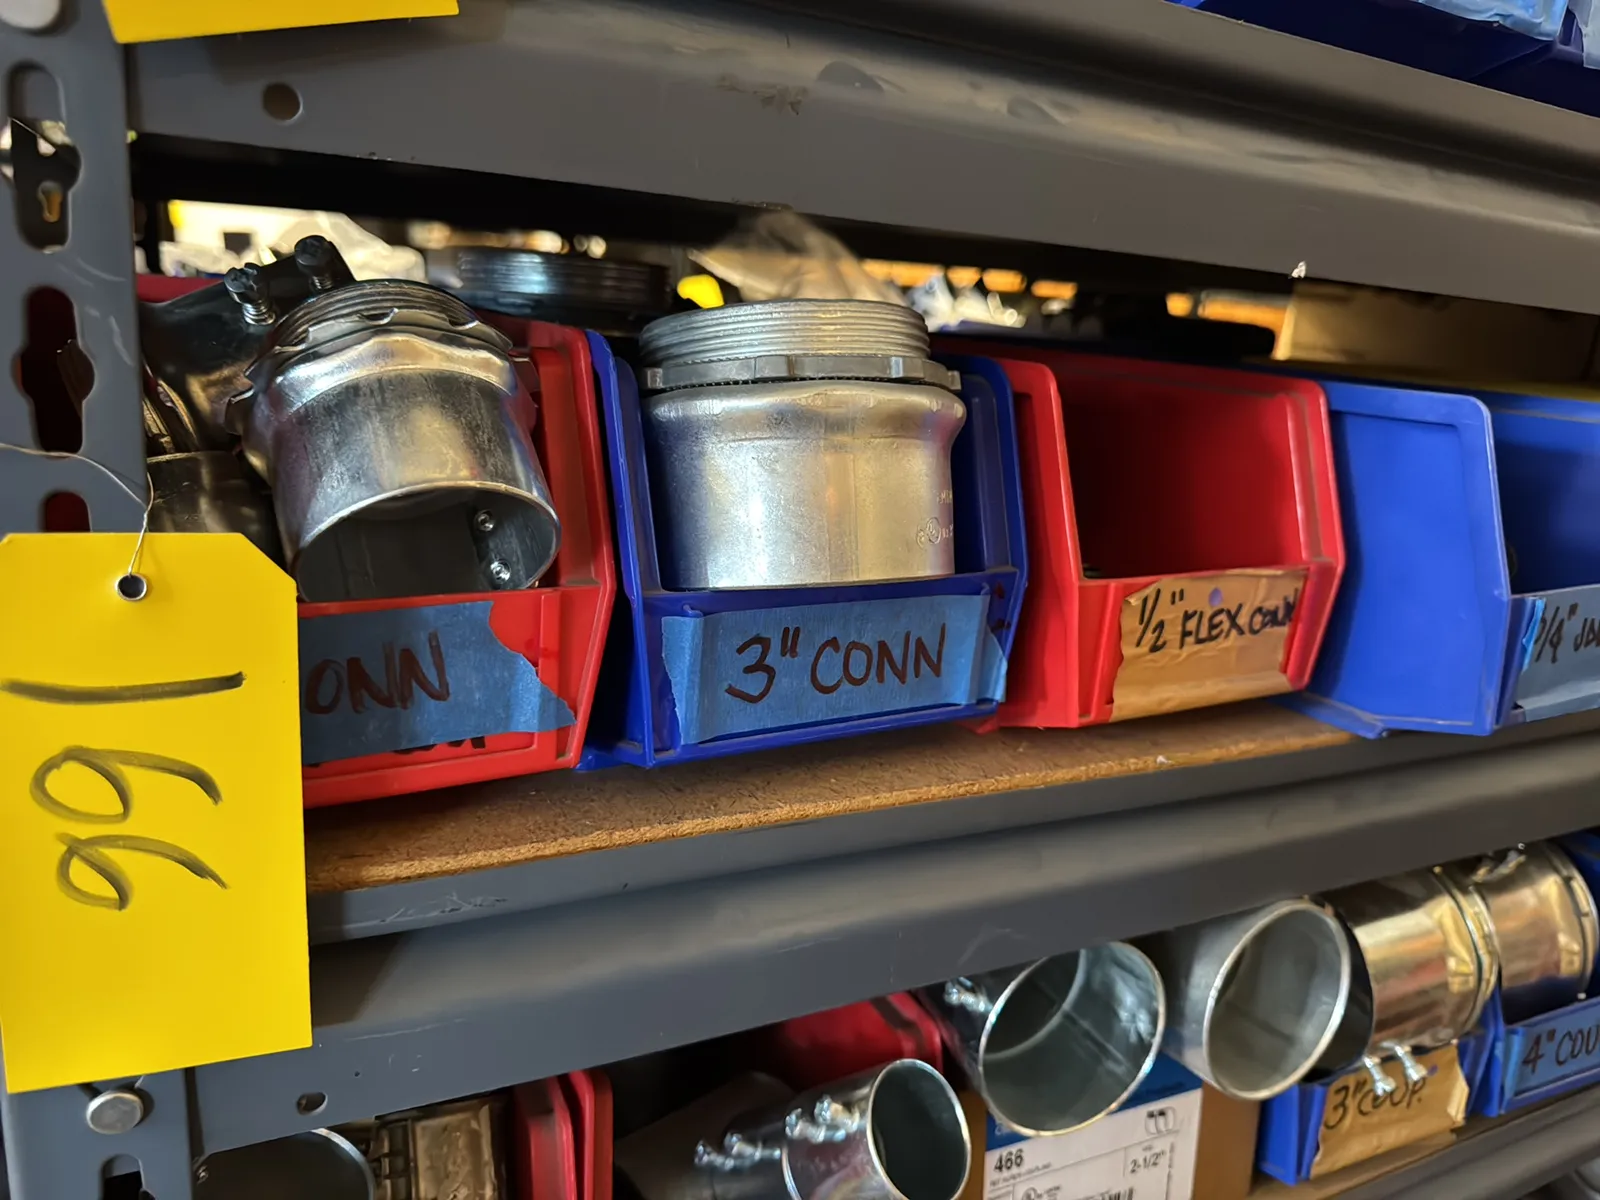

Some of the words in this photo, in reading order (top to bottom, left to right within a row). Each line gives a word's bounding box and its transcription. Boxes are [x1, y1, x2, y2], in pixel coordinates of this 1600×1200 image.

[1135, 587, 1185, 654] 1/2"
[1178, 602, 1246, 650] FLEX
[723, 626, 801, 704] 3"
[809, 621, 947, 695] CONN
[1521, 1027, 1558, 1076] 4"
[1323, 1077, 1368, 1130] 3"
[993, 1148, 1025, 1173] 466
